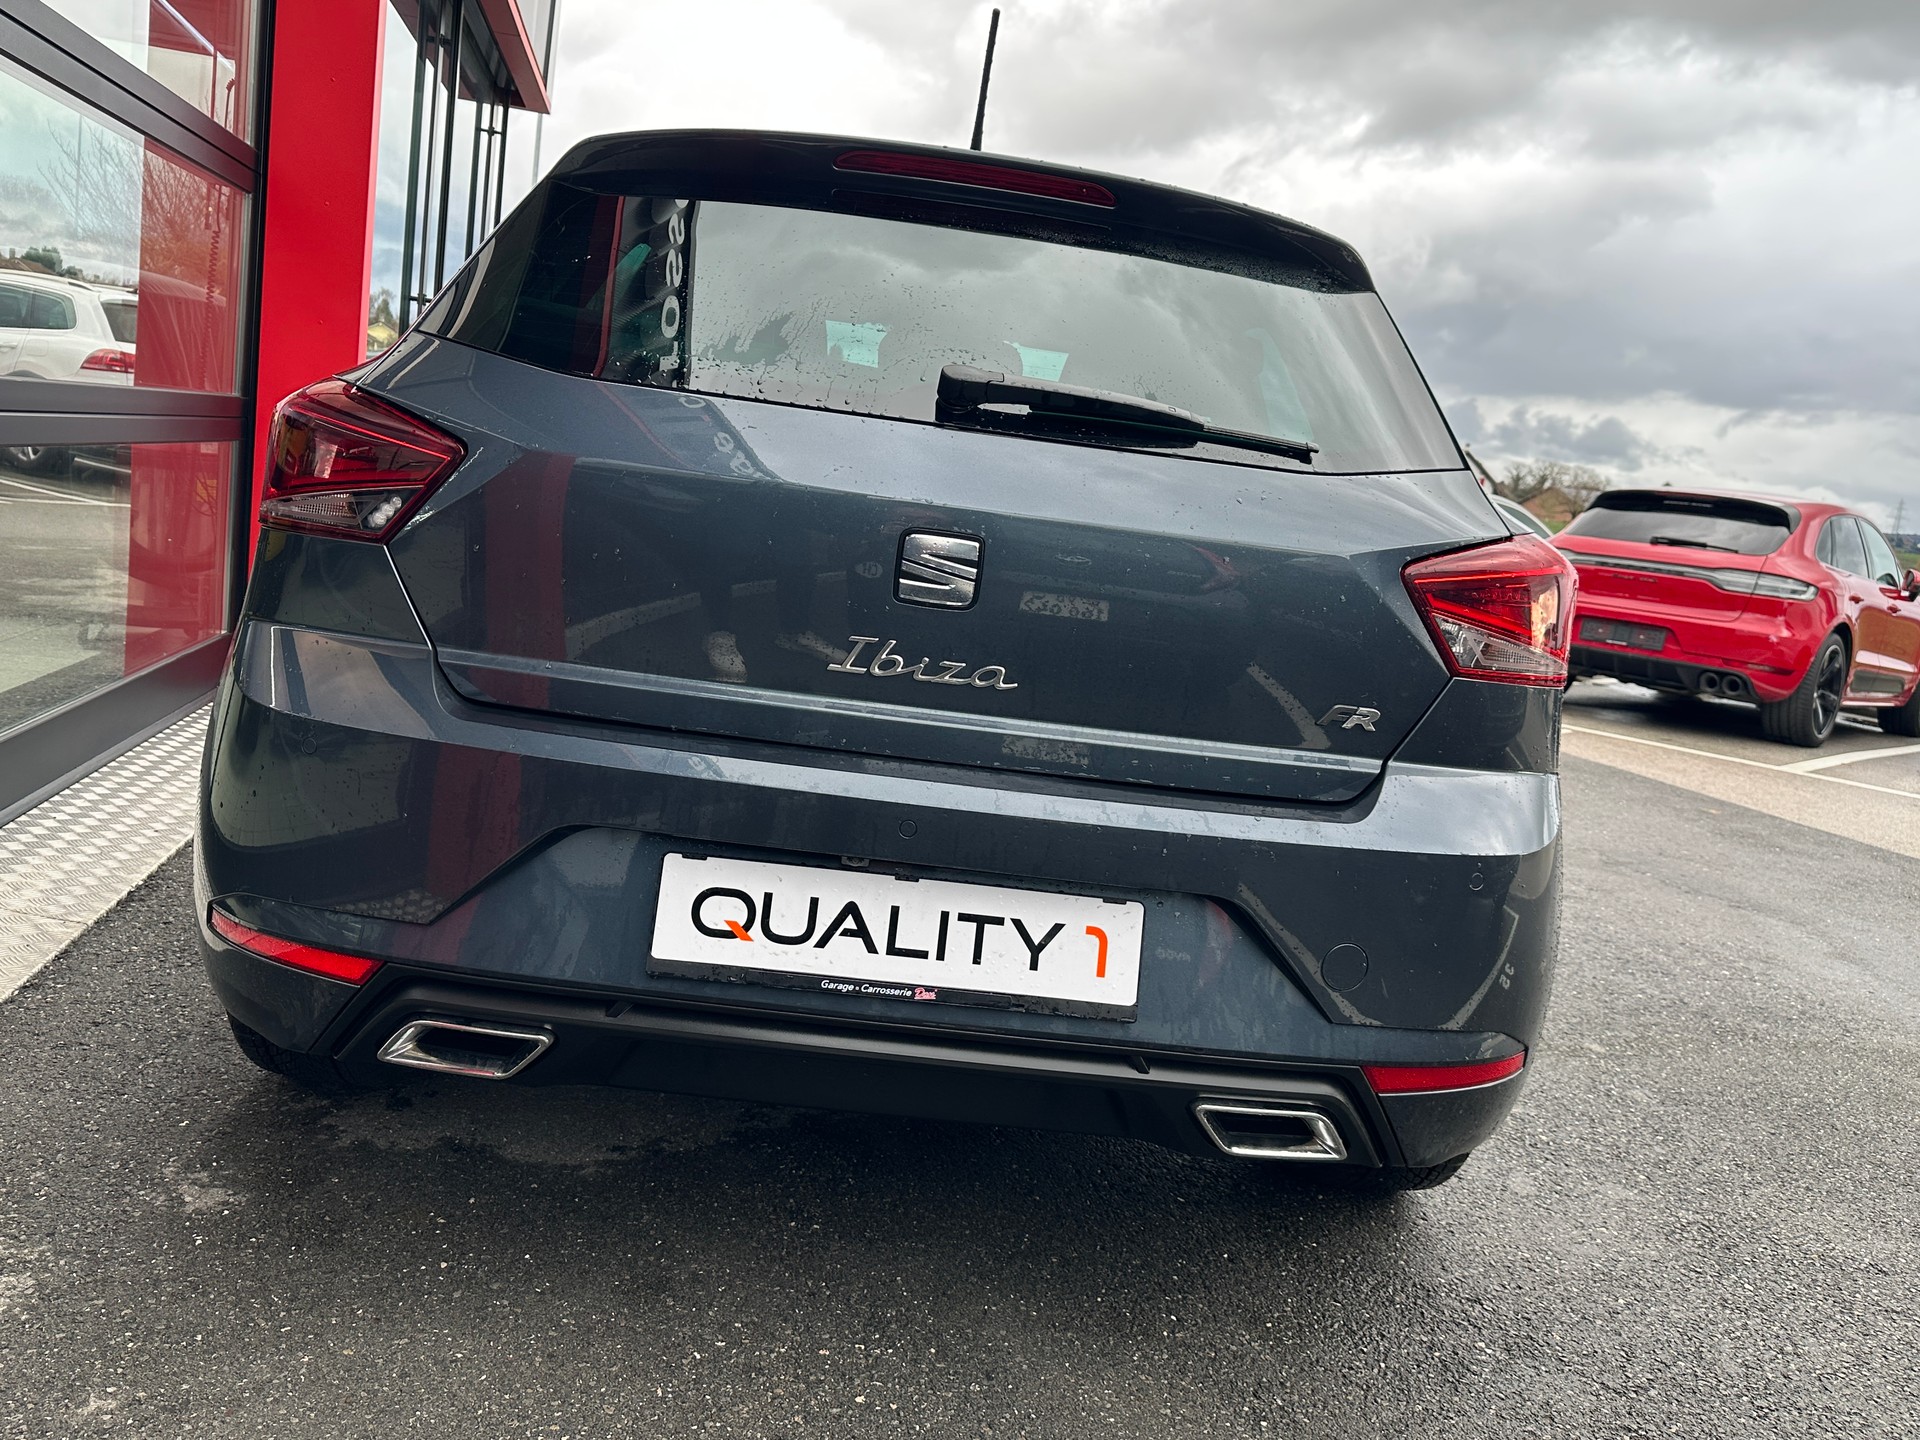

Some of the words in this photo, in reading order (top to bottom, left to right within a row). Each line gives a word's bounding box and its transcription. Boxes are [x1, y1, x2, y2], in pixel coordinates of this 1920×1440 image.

[827, 635, 1018, 690] Ibiza
[1316, 704, 1381, 731] FR
[690, 886, 1066, 971] QUALITY
[1085, 925, 1108, 978] 1
[820, 980, 854, 992] Garage
[861, 984, 912, 997] Carrosserie
